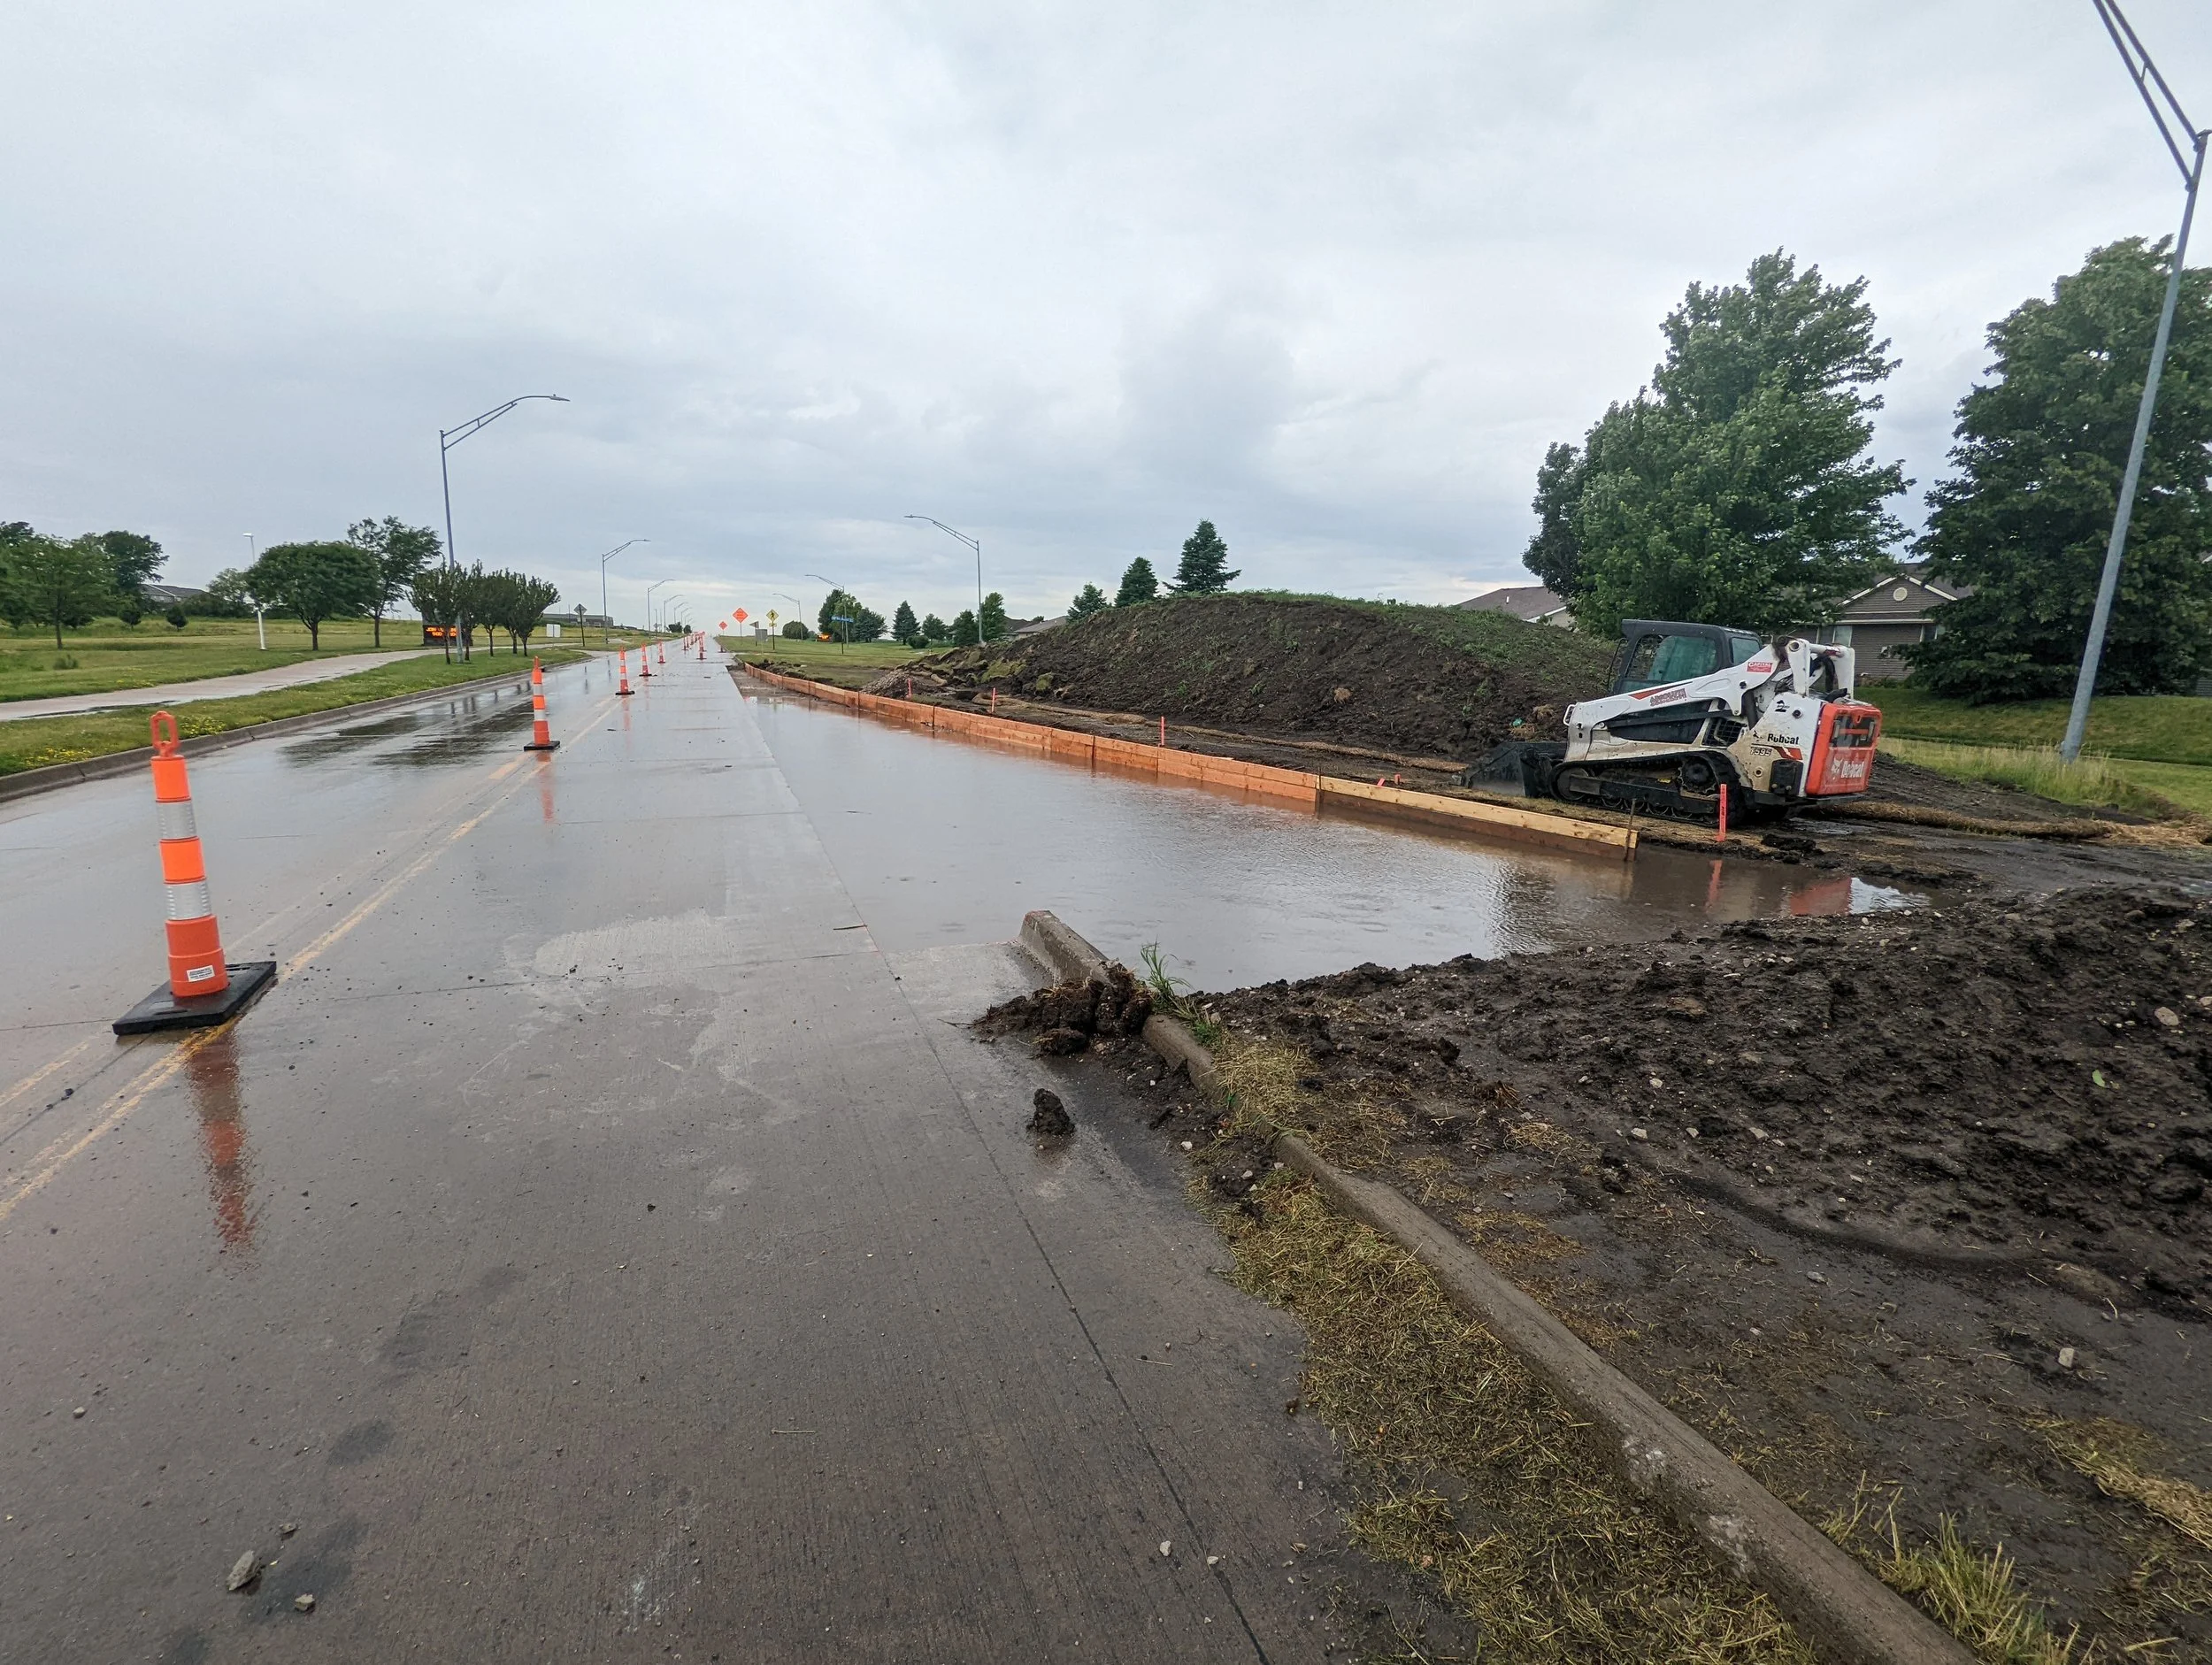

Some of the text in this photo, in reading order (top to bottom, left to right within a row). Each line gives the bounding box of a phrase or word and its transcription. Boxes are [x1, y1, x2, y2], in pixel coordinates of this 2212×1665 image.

[1767, 733, 1800, 745] Bobcat
[1750, 746, 1773, 756] T595
[1840, 760, 1865, 779] Bobcat
